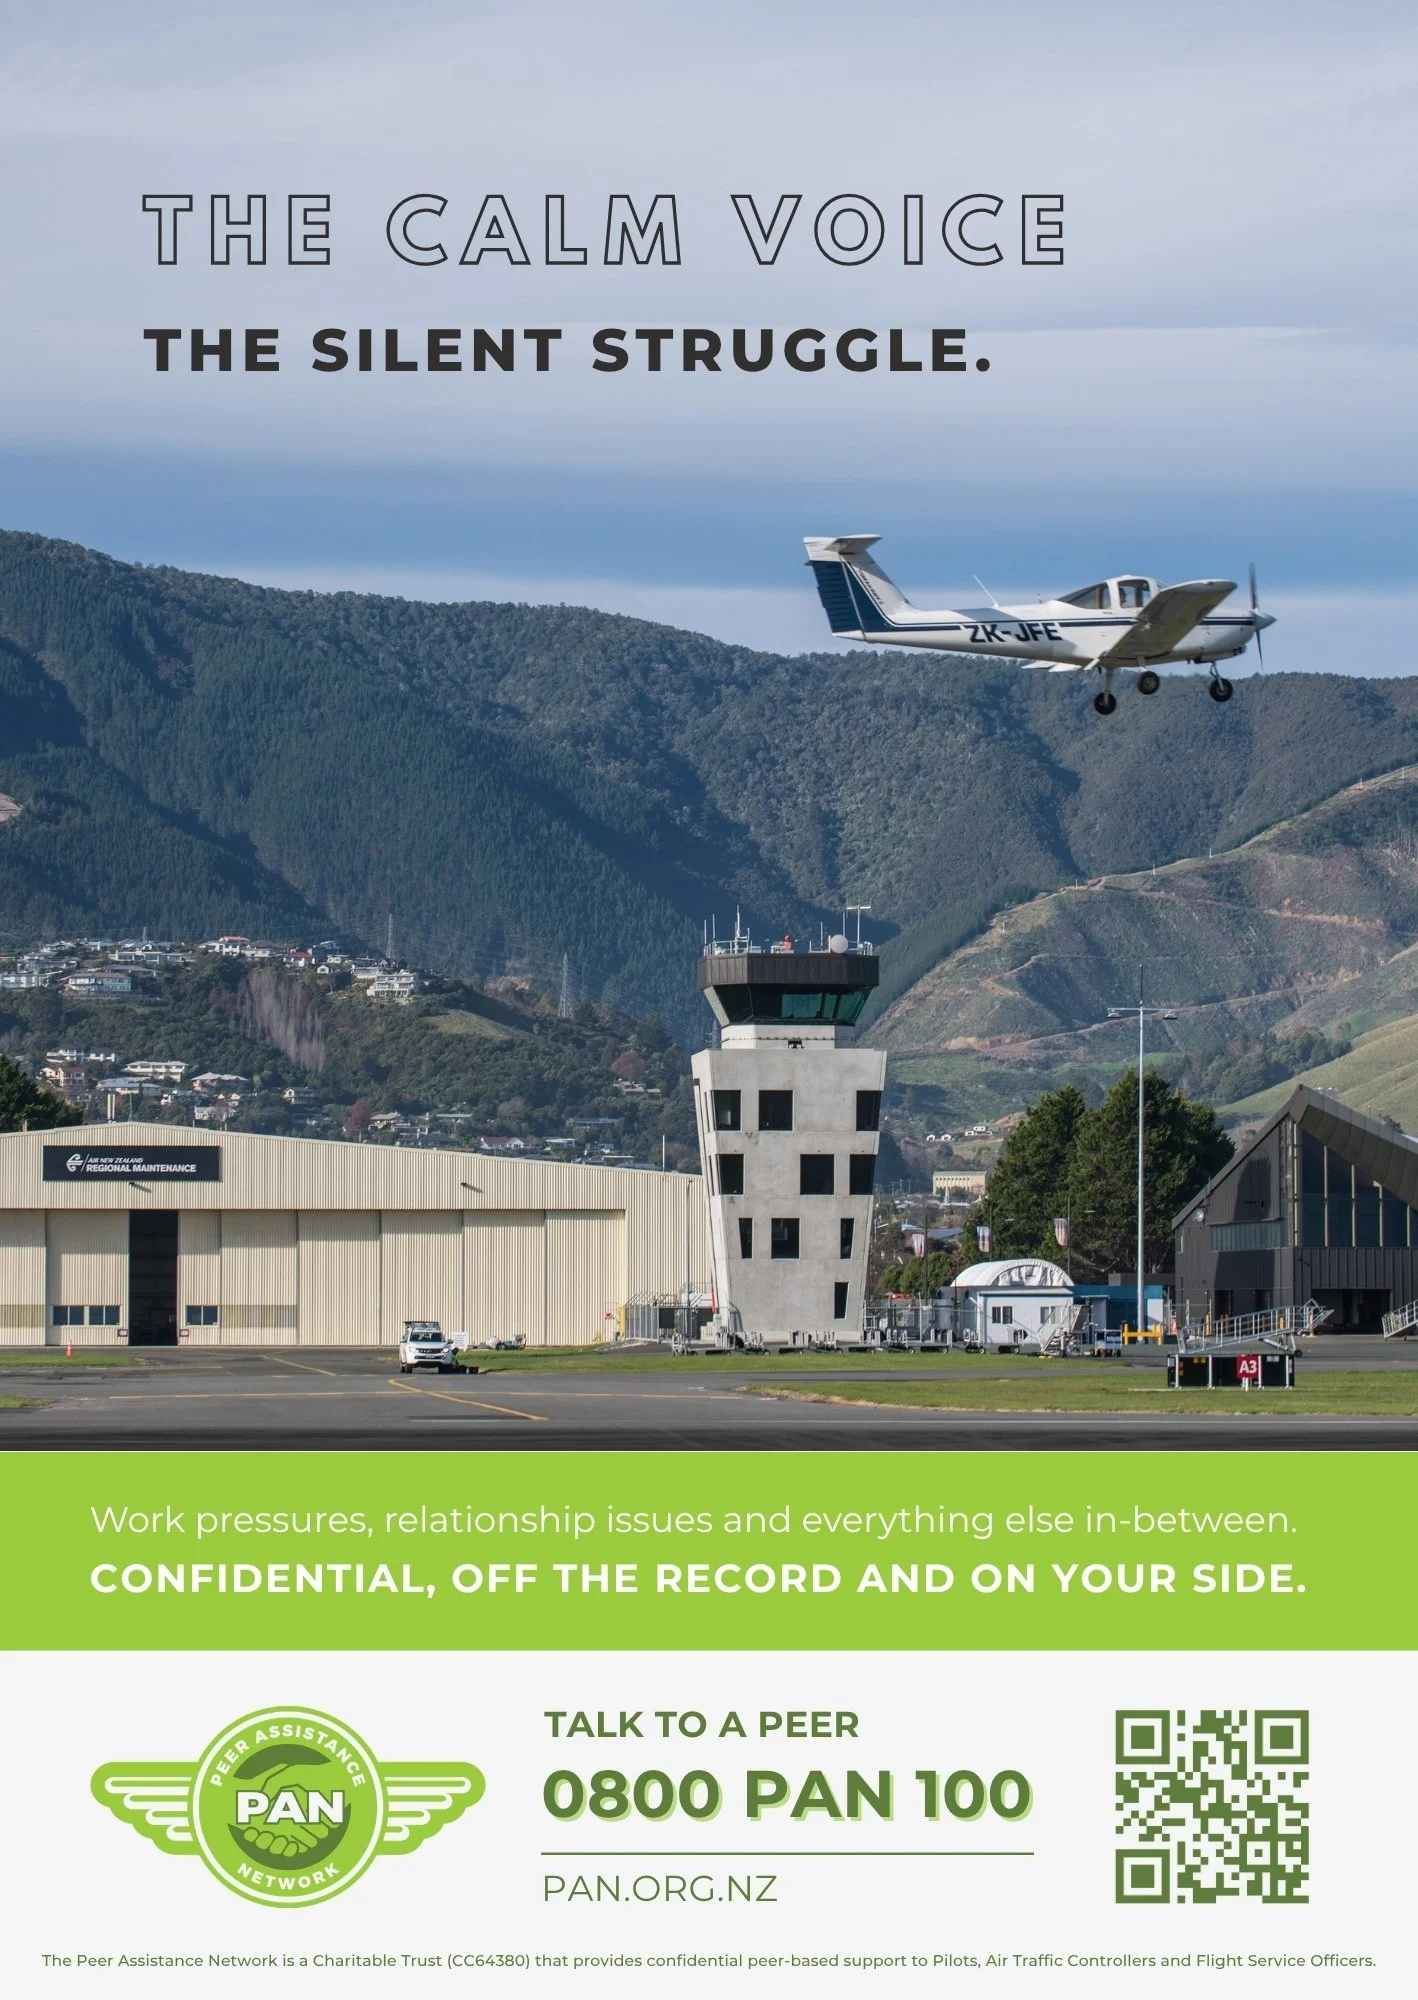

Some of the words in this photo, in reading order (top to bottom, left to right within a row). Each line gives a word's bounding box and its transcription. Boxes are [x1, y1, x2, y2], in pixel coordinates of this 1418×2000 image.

[969, 622, 1063, 643] ZK-JFE
[86, 1164, 131, 1172] REGIONAL
[132, 1164, 196, 1172] MAINTENANCE
[1239, 1360, 1257, 1374] A3
